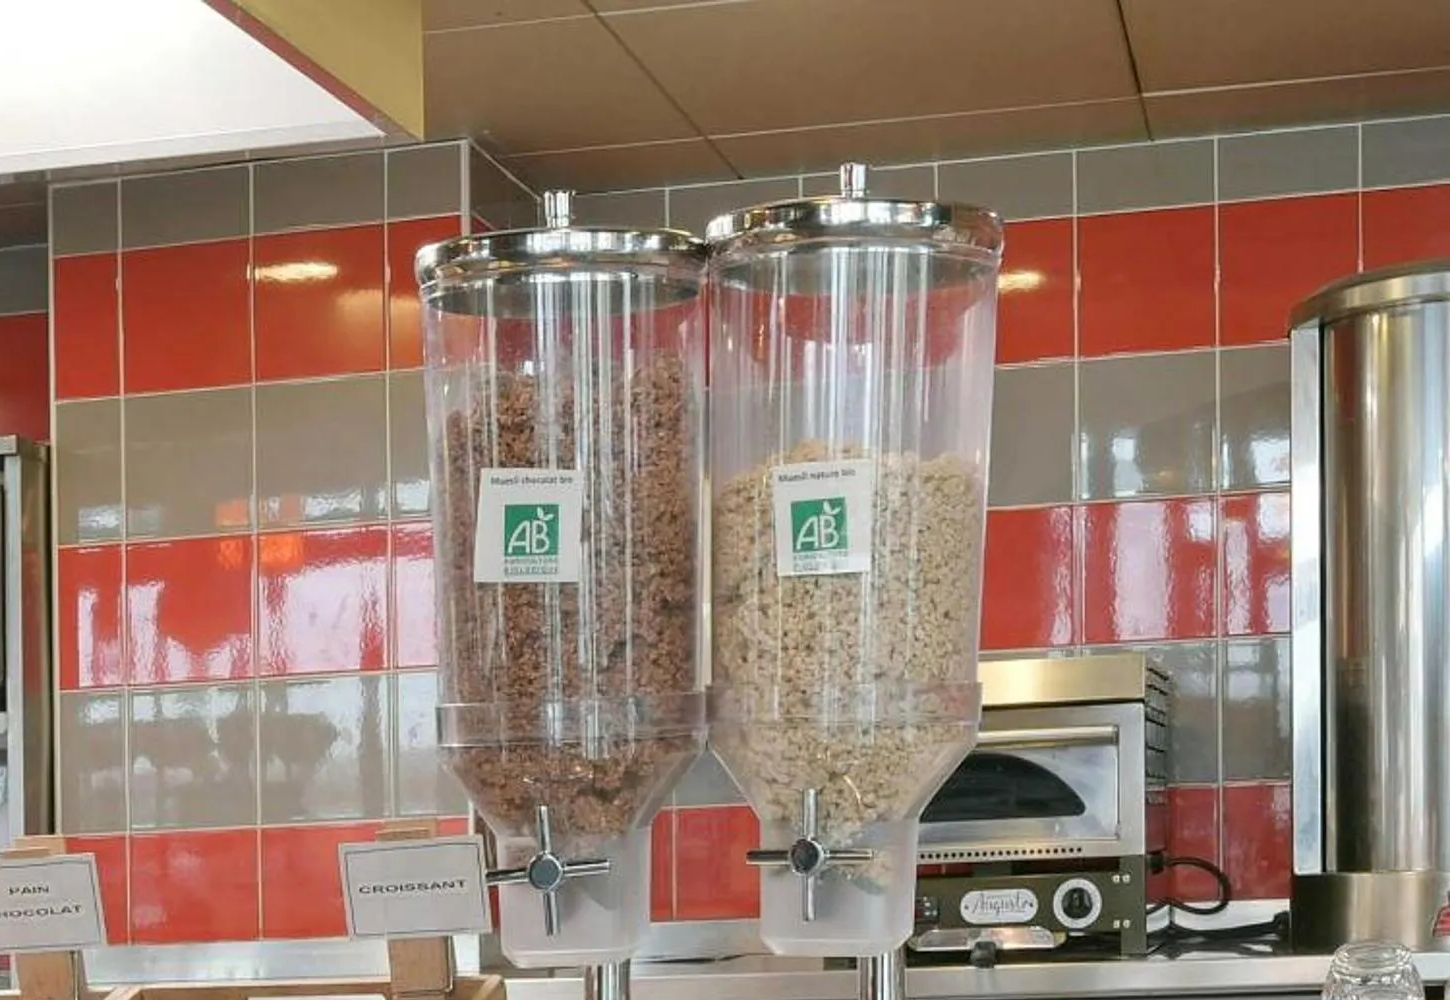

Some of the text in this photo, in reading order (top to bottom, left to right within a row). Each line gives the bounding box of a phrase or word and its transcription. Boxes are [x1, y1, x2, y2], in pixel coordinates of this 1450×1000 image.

[508, 519, 550, 554] AB
[796, 514, 840, 550] AB
[9, 885, 49, 896] PAIN
[358, 879, 467, 894] CROISSANT
